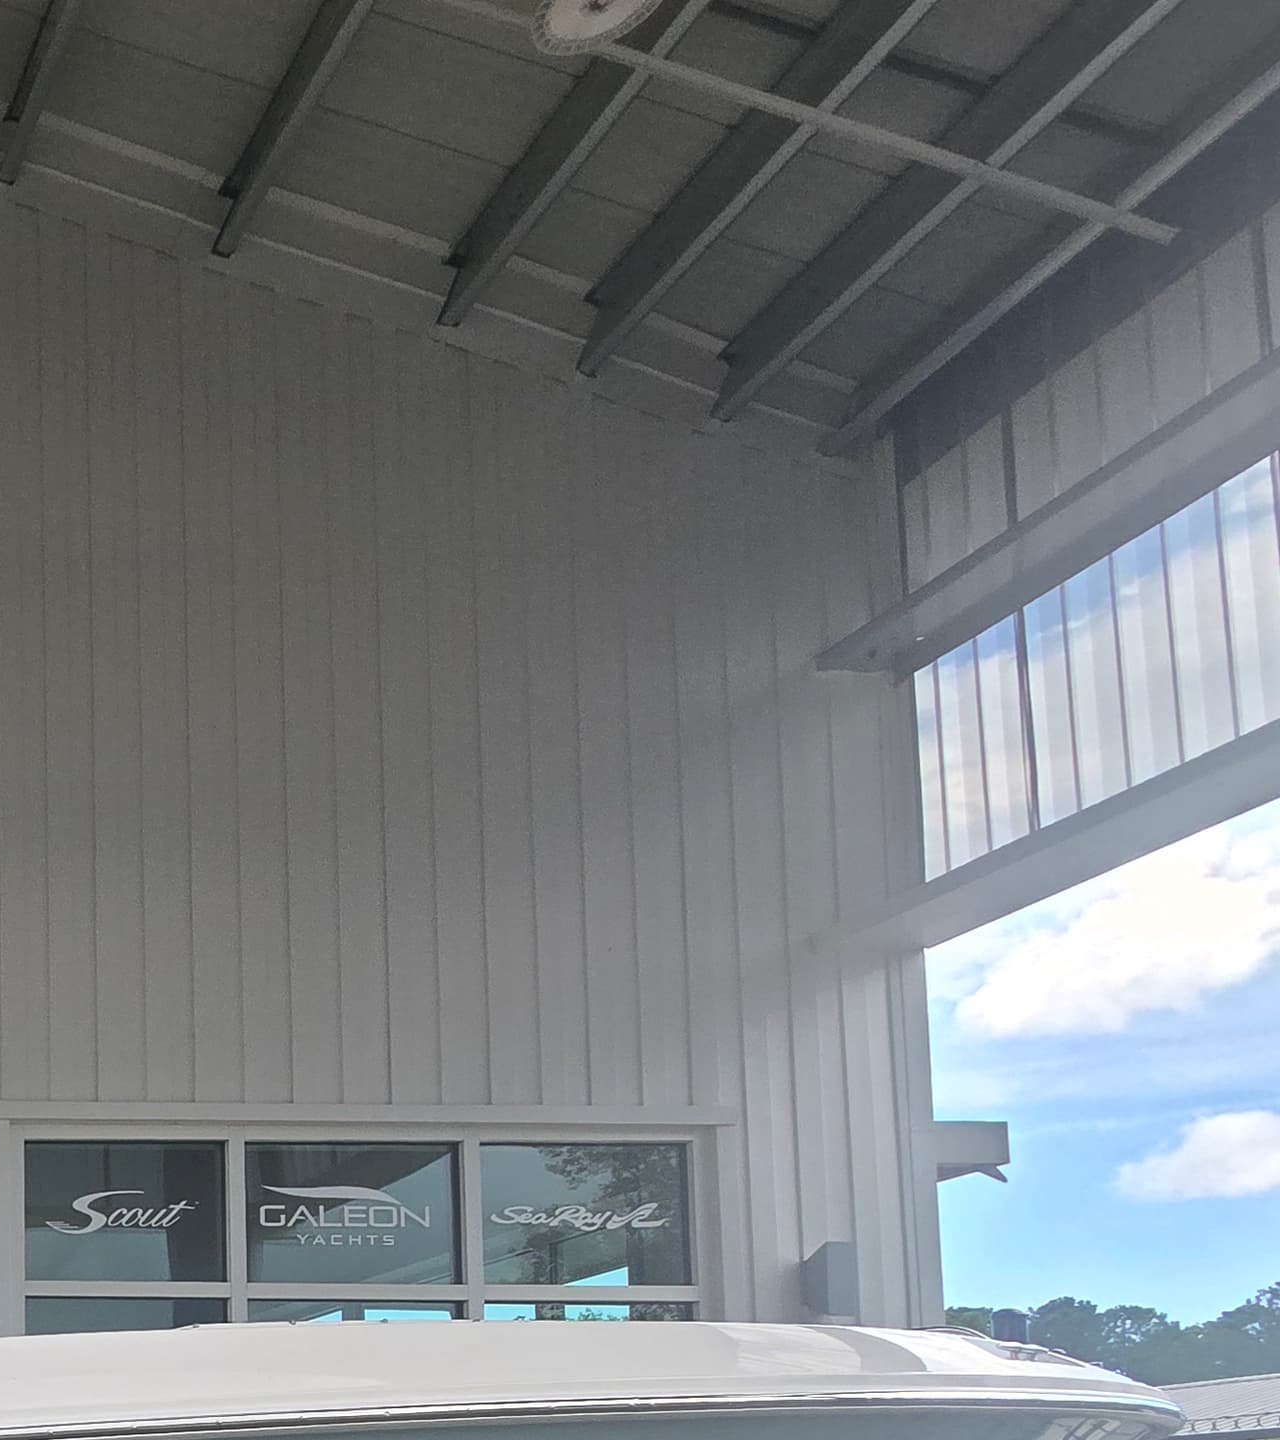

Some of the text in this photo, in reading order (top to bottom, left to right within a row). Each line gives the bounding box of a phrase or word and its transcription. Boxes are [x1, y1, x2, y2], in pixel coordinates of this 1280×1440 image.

[45, 1190, 196, 1235] Scout
[259, 1204, 431, 1228] GALEON
[296, 1234, 396, 1246] YACHTS
